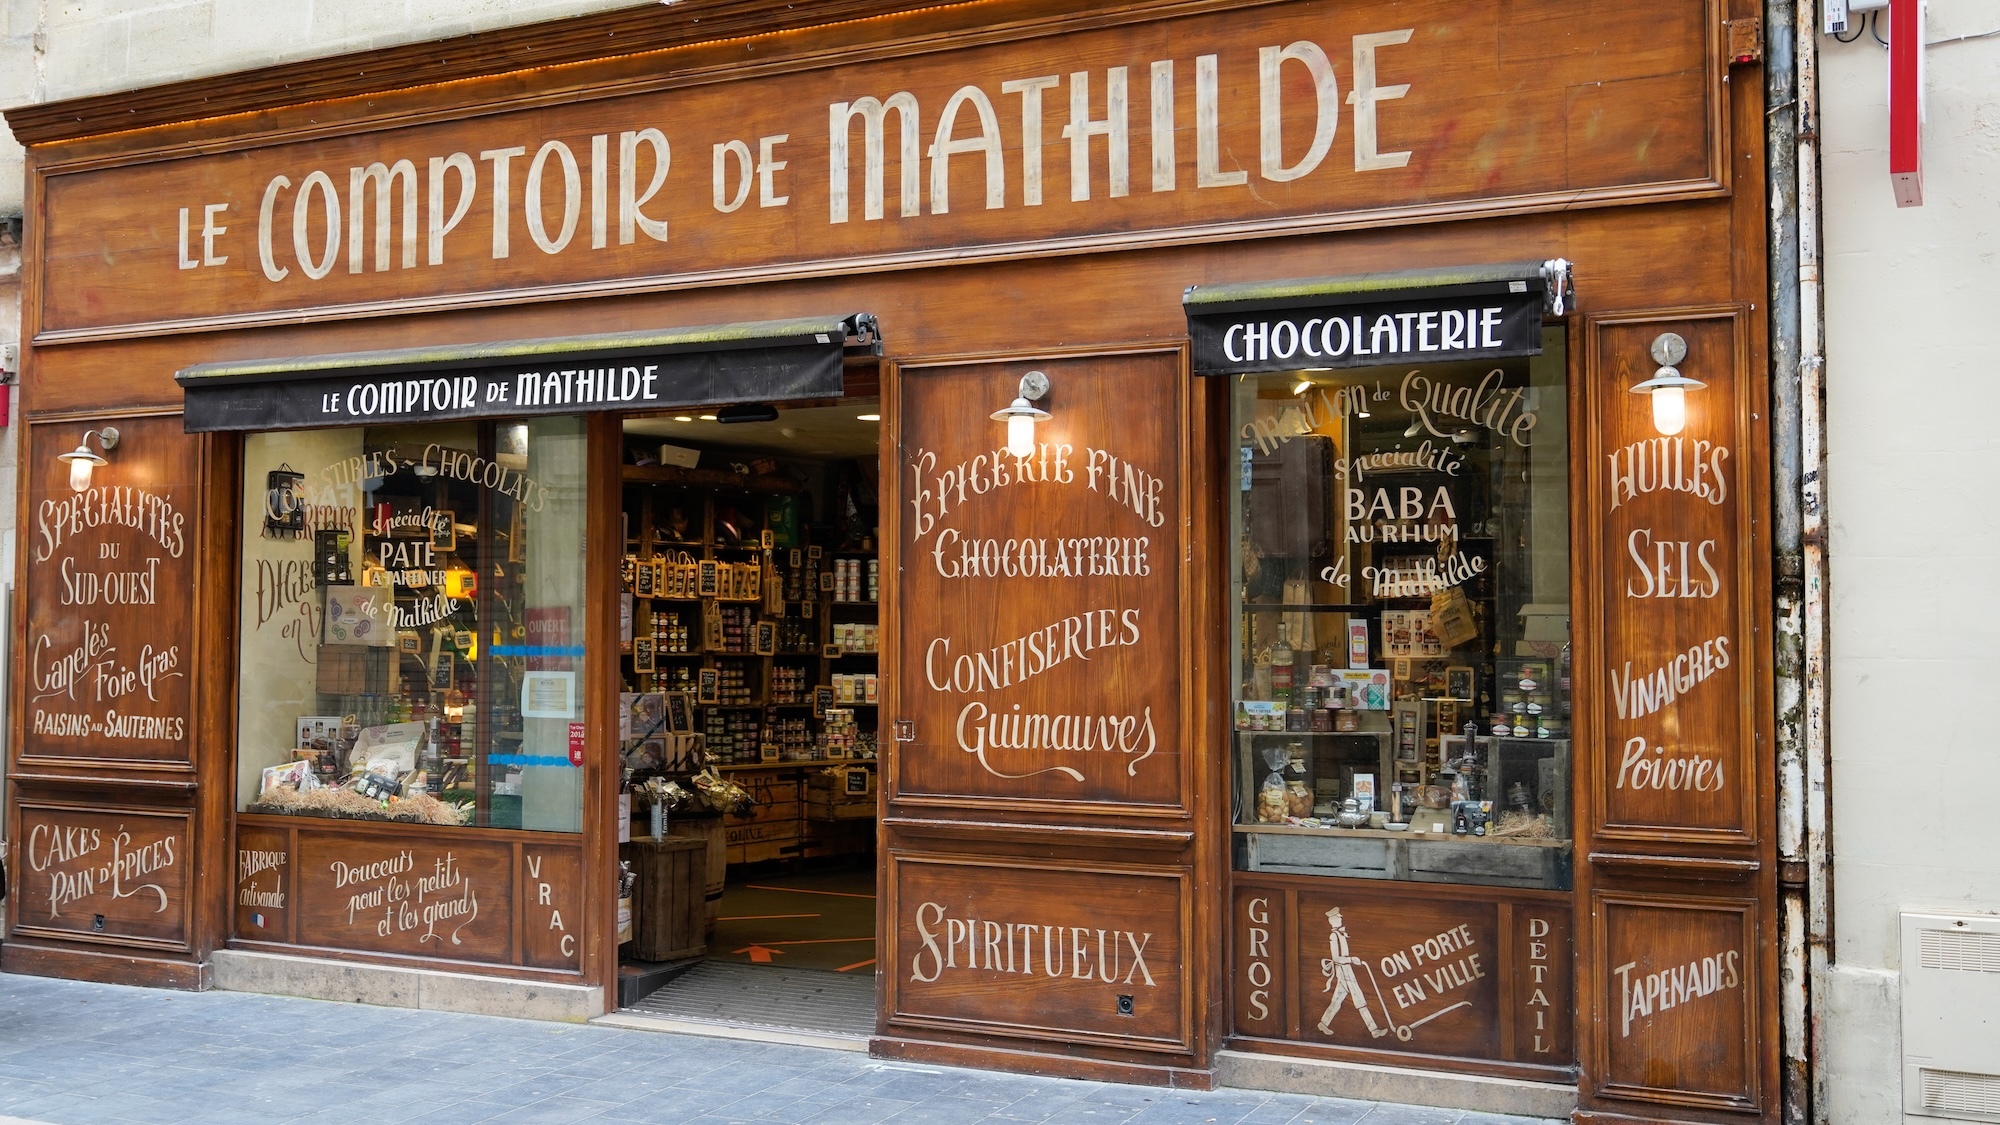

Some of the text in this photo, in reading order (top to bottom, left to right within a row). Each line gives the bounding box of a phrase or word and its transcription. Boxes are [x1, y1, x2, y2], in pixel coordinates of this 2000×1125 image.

[178, 28, 1415, 283] LE COMPTOIR DE MATHILDE
[1223, 307, 1503, 363] CHOCOLATERIE
[322, 365, 659, 416] LE COMPTOIR DE MATHILDE
[1372, 380, 1391, 402] de
[1400, 368, 1541, 447] Qualité
[422, 443, 549, 513] CHOCOLATS
[1087, 447, 1165, 528] FINE
[1344, 485, 1456, 520] BABA
[1607, 436, 1730, 515] HUILES
[99, 542, 121, 559] DU
[380, 541, 436, 567] PATE
[931, 528, 1151, 578] CHOCOLATERIE
[1343, 524, 1460, 543] AU RHUM
[61, 557, 160, 606] SUD-OUEST
[1321, 551, 1488, 598] de Mathilde
[1627, 527, 1721, 600] SELS
[361, 594, 461, 628] de Mathilde
[529, 619, 565, 633] OUVERT
[32, 620, 116, 703] Canelés
[96, 644, 184, 702] Foie Gras
[925, 608, 1141, 693] CONFISERIES
[1610, 635, 1730, 720] VINAIGRES
[33, 709, 184, 741] RAISINS AU SAUTERNES
[956, 701, 1156, 782] Guimauves
[1616, 735, 1725, 793] Poivres
[28, 824, 101, 872] CAKES
[238, 849, 287, 885] FABRIQUE
[330, 850, 414, 889] Douceurs
[48, 867, 95, 921] PAIN
[239, 874, 285, 909] artisanale
[344, 852, 460, 925] pour les petits
[377, 877, 478, 945] et les grands
[526, 855, 575, 957] VRAC
[910, 902, 1157, 987] SPIRITUEUX
[1248, 898, 1271, 1021] GROS
[1381, 923, 1475, 978] ON PORTE
[1392, 953, 1486, 1009] EN VILLE
[1614, 950, 1739, 1038] TAPENADES
